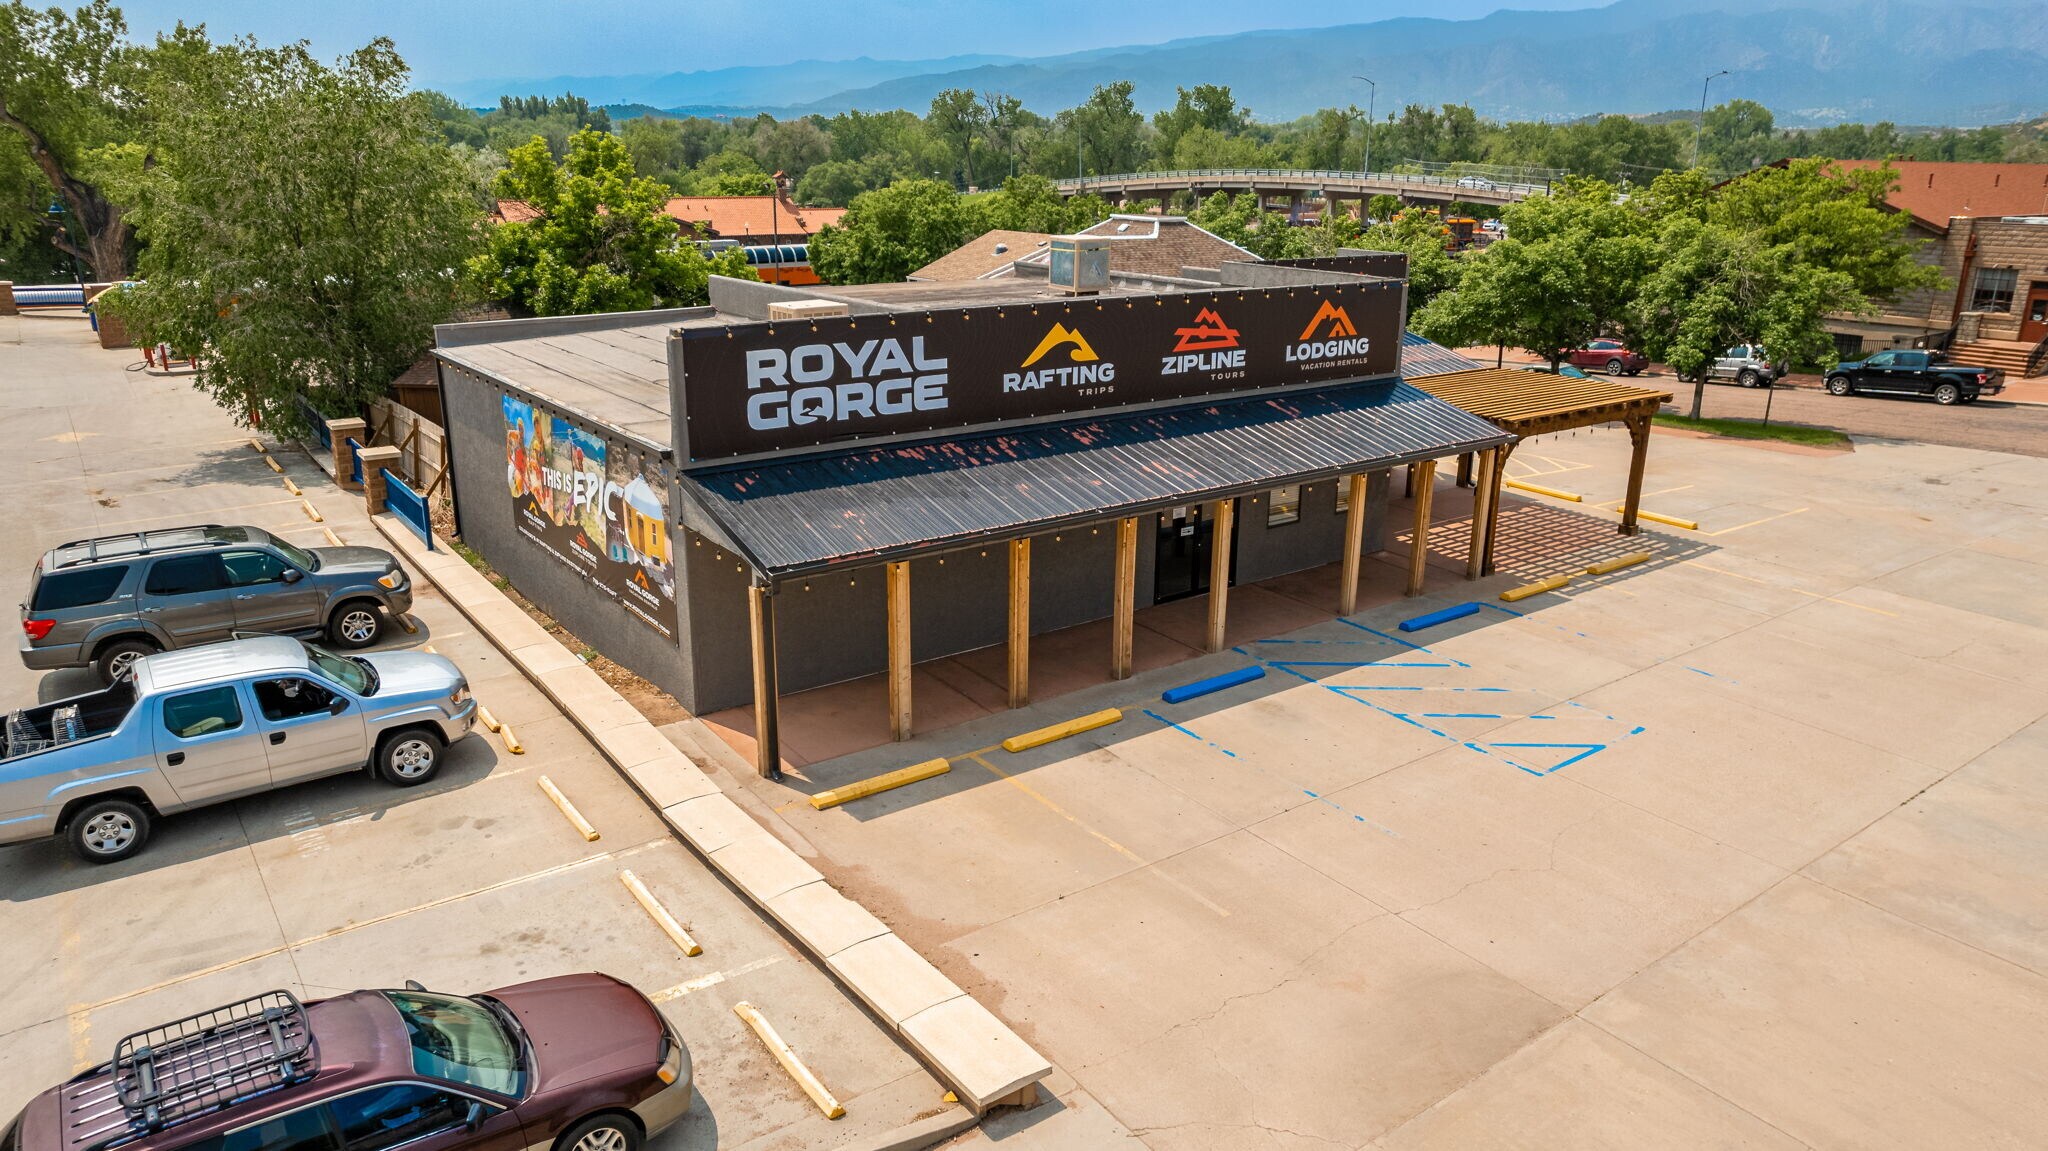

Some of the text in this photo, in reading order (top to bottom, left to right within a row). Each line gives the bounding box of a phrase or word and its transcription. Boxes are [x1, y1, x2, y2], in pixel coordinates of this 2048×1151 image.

[746, 336, 948, 388] ROYAL
[1161, 350, 1246, 376] ZIPLINE
[1286, 338, 1369, 362] LODGING
[1210, 370, 1246, 380] TOURS
[1300, 357, 1368, 370] VACATION RENTALS
[1003, 362, 1114, 392] RAFTING
[747, 374, 949, 431] GORGE
[1078, 386, 1114, 396] TRIPS
[542, 466, 624, 521] THIS IS EPIC
